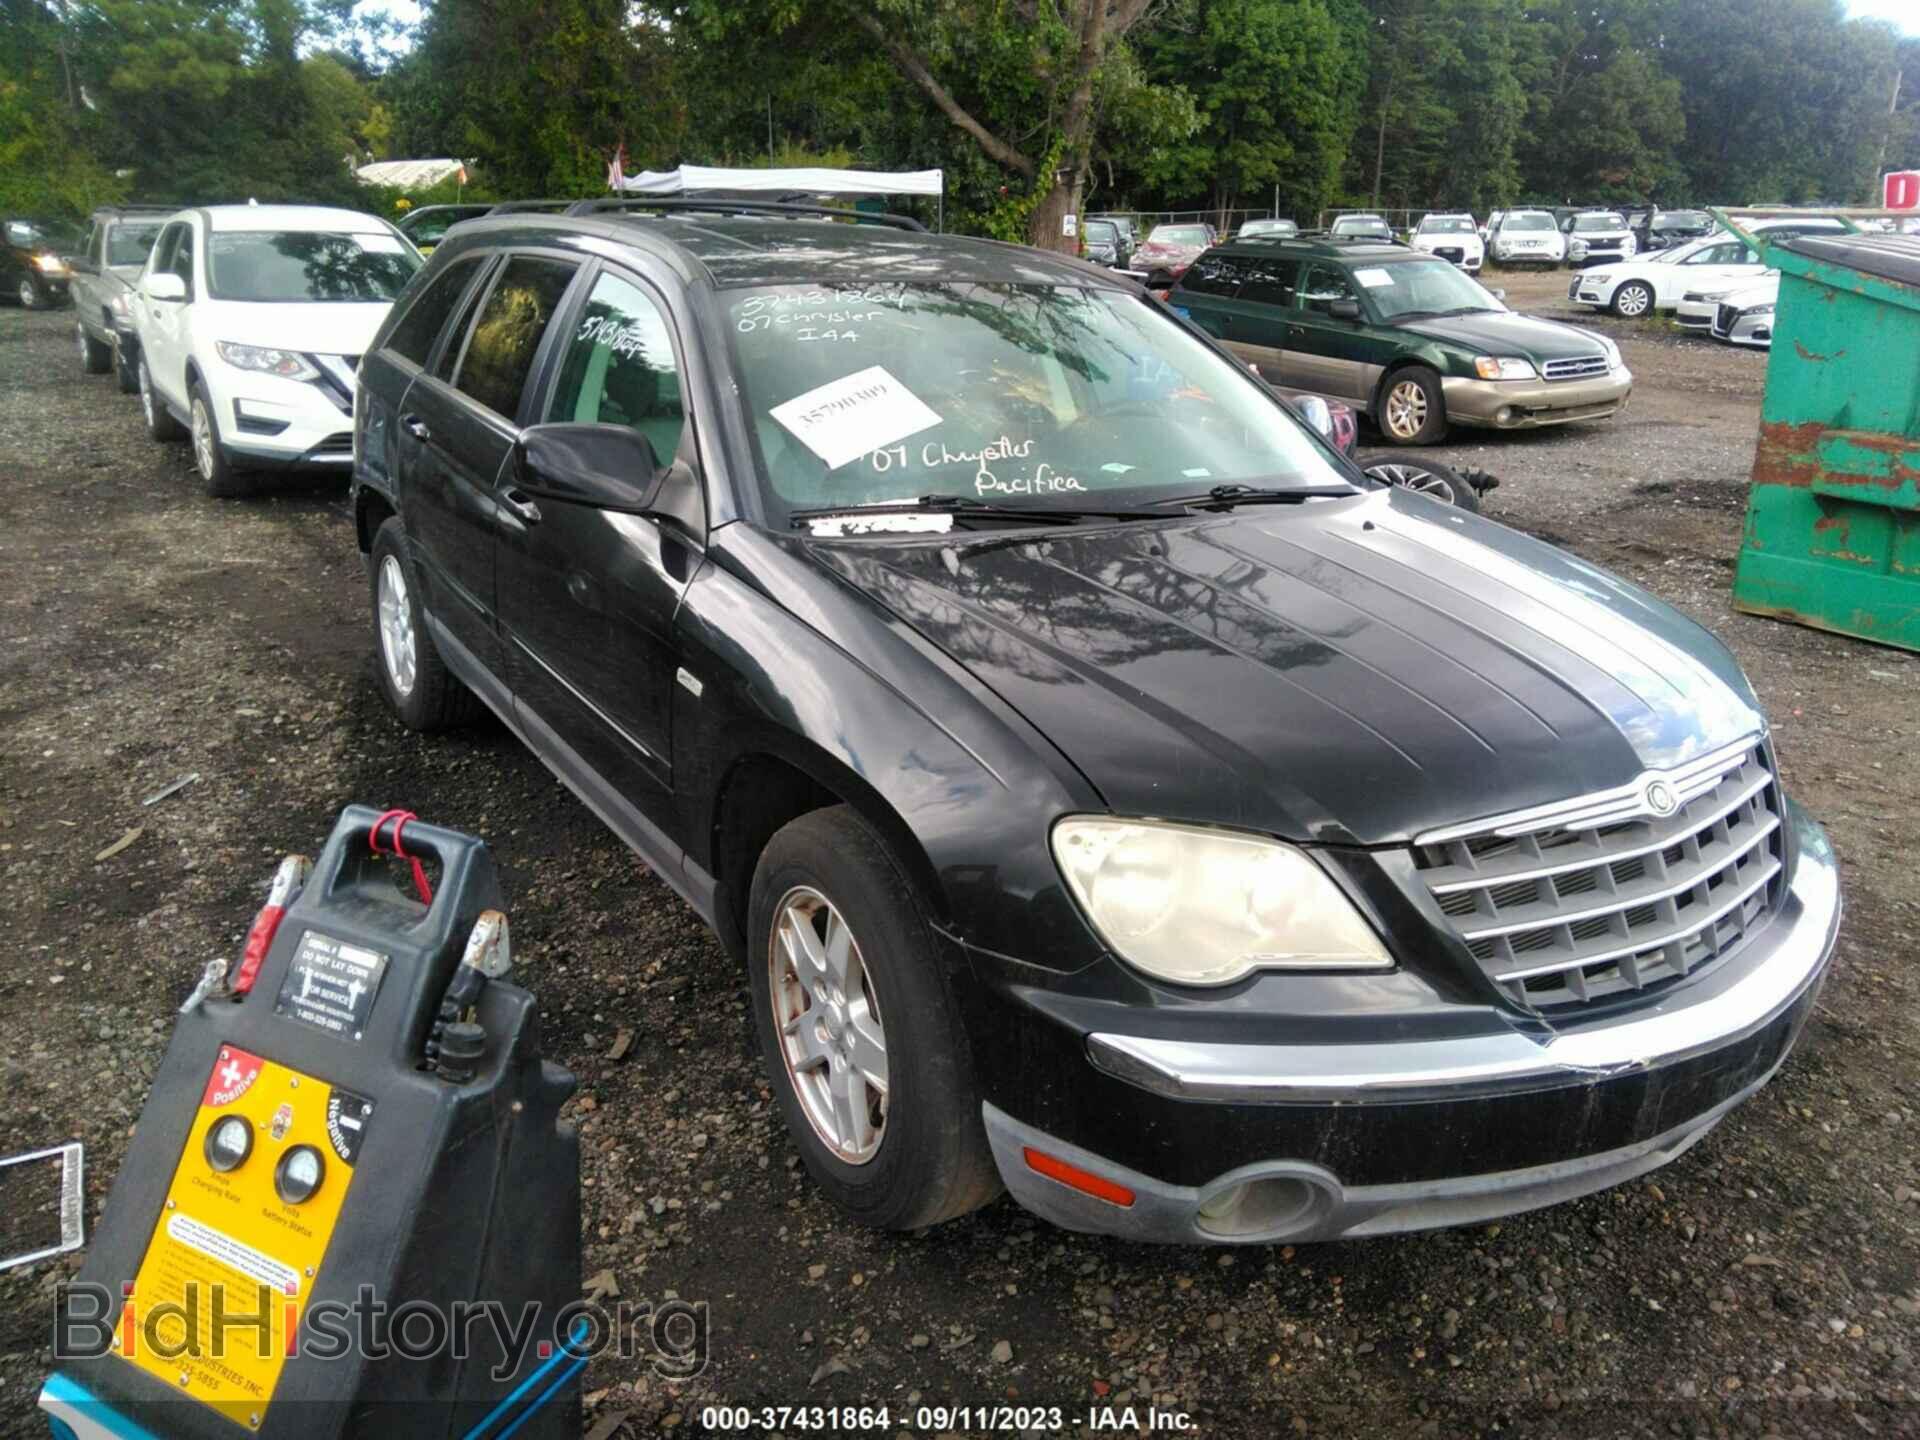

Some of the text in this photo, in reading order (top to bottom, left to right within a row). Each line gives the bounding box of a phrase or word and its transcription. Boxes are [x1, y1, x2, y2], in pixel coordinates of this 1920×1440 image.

[738, 315, 771, 332] 07
[974, 463, 1088, 496] Pacifica
[213, 1069, 257, 1105] Positive
[327, 1098, 350, 1159] Negative
[288, 1217, 313, 1238] Status
